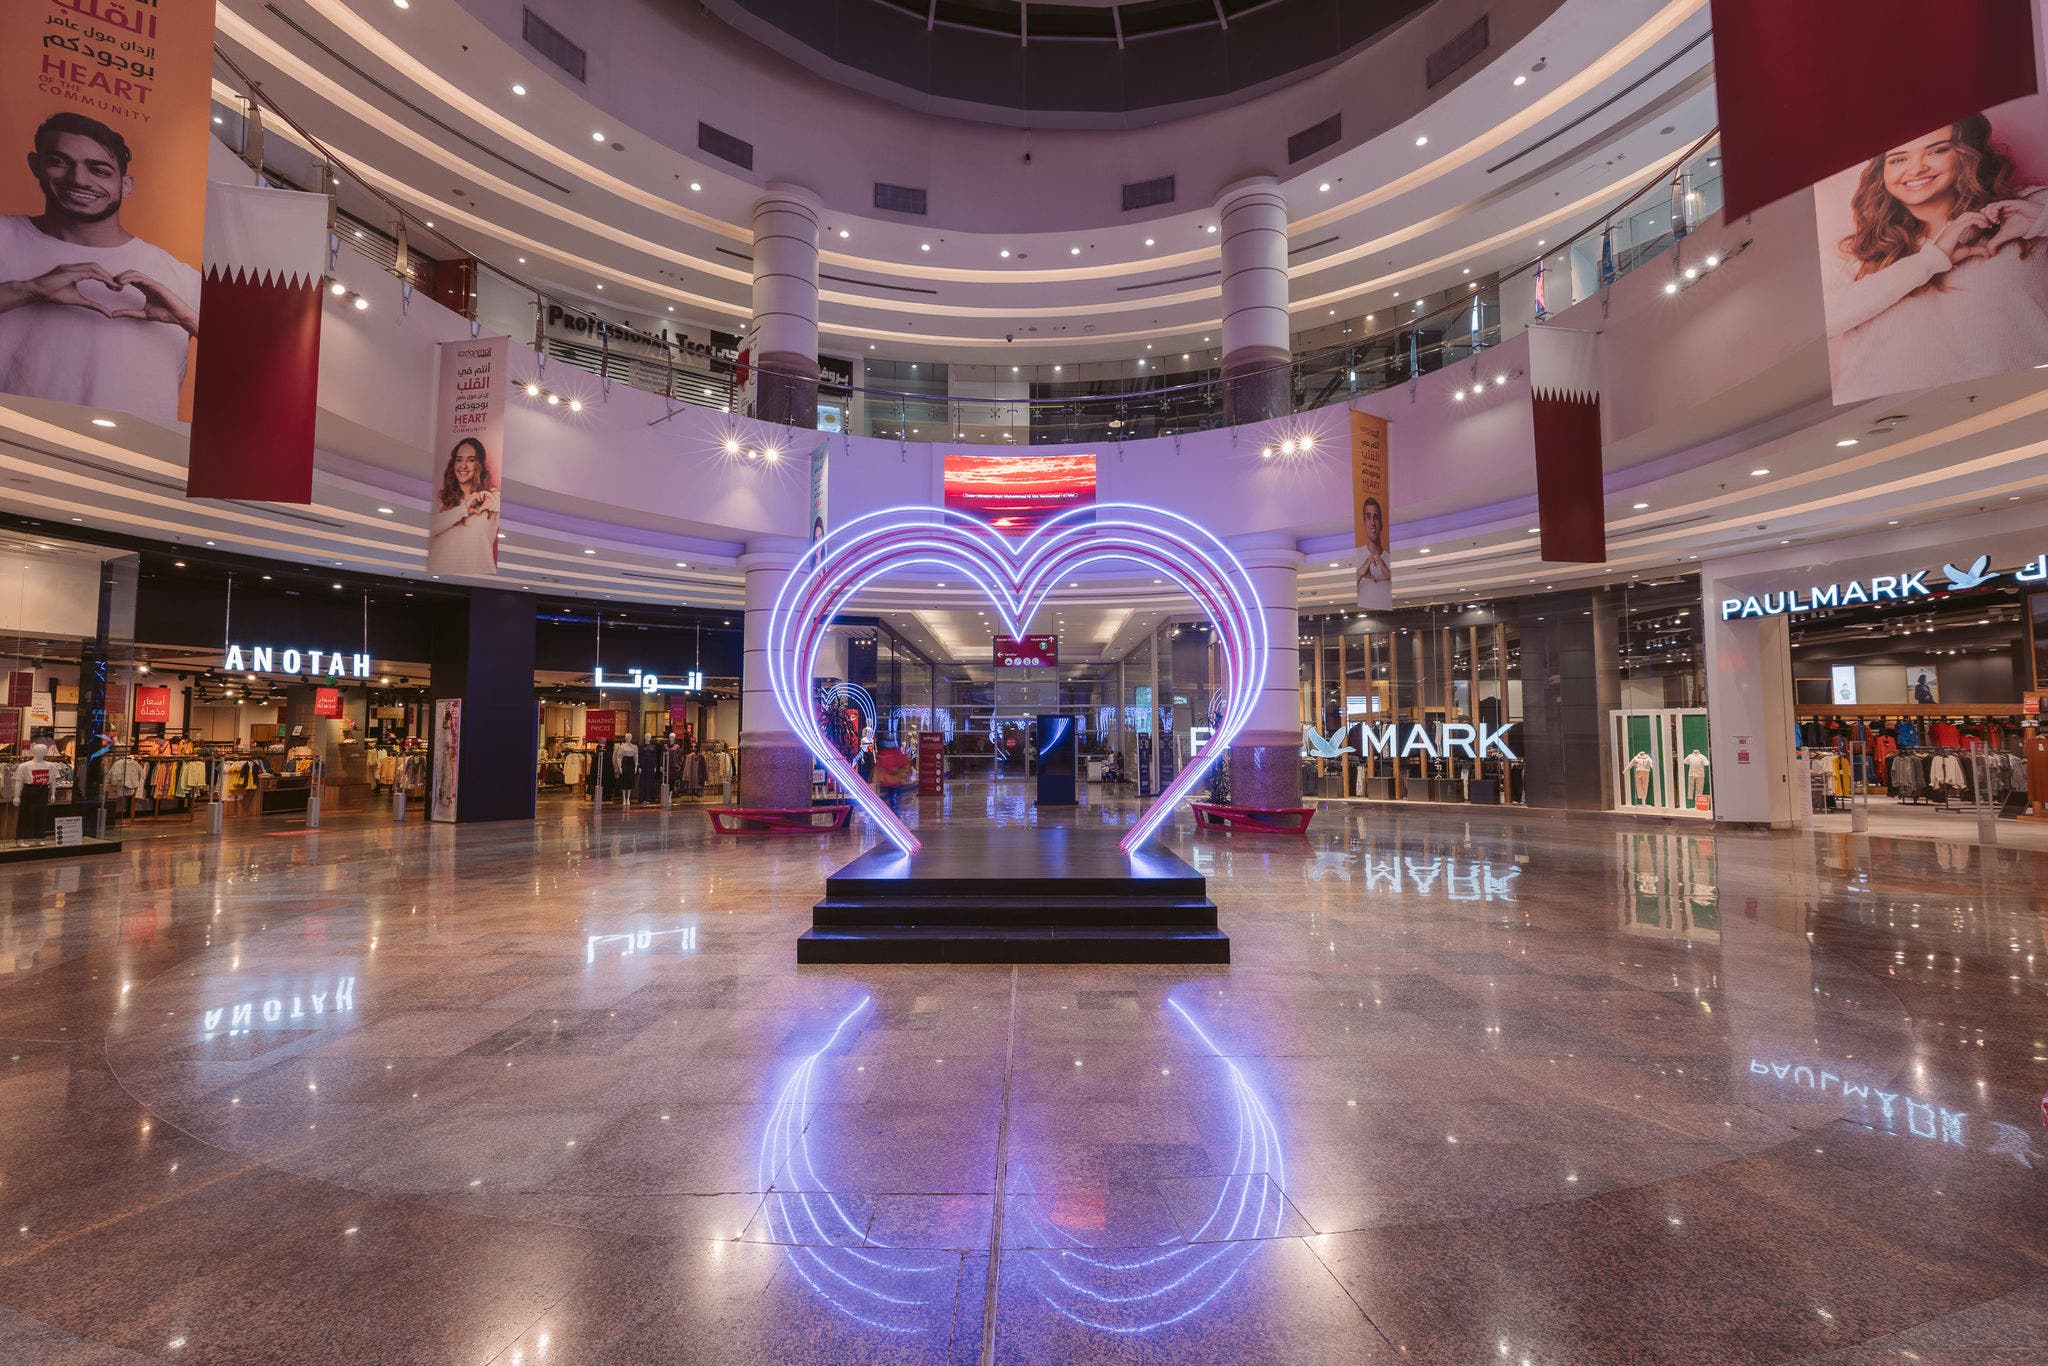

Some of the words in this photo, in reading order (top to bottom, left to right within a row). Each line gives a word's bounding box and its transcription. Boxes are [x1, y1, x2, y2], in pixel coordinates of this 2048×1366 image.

[83, 26, 116, 43] مول
[43, 34, 154, 80] بوجودكم
[39, 74, 54, 84] OF
[61, 80, 81, 92] THE
[42, 54, 153, 104] HEART
[39, 82, 151, 124] COMMUNITY
[457, 367, 473, 377] في
[457, 376, 490, 393] القلب
[454, 412, 488, 425] HEART
[1721, 570, 1931, 621] PAULMARK
[223, 644, 370, 678] ANOTAH
[142, 695, 166, 707] أسعار
[1361, 722, 1518, 760] MARK
